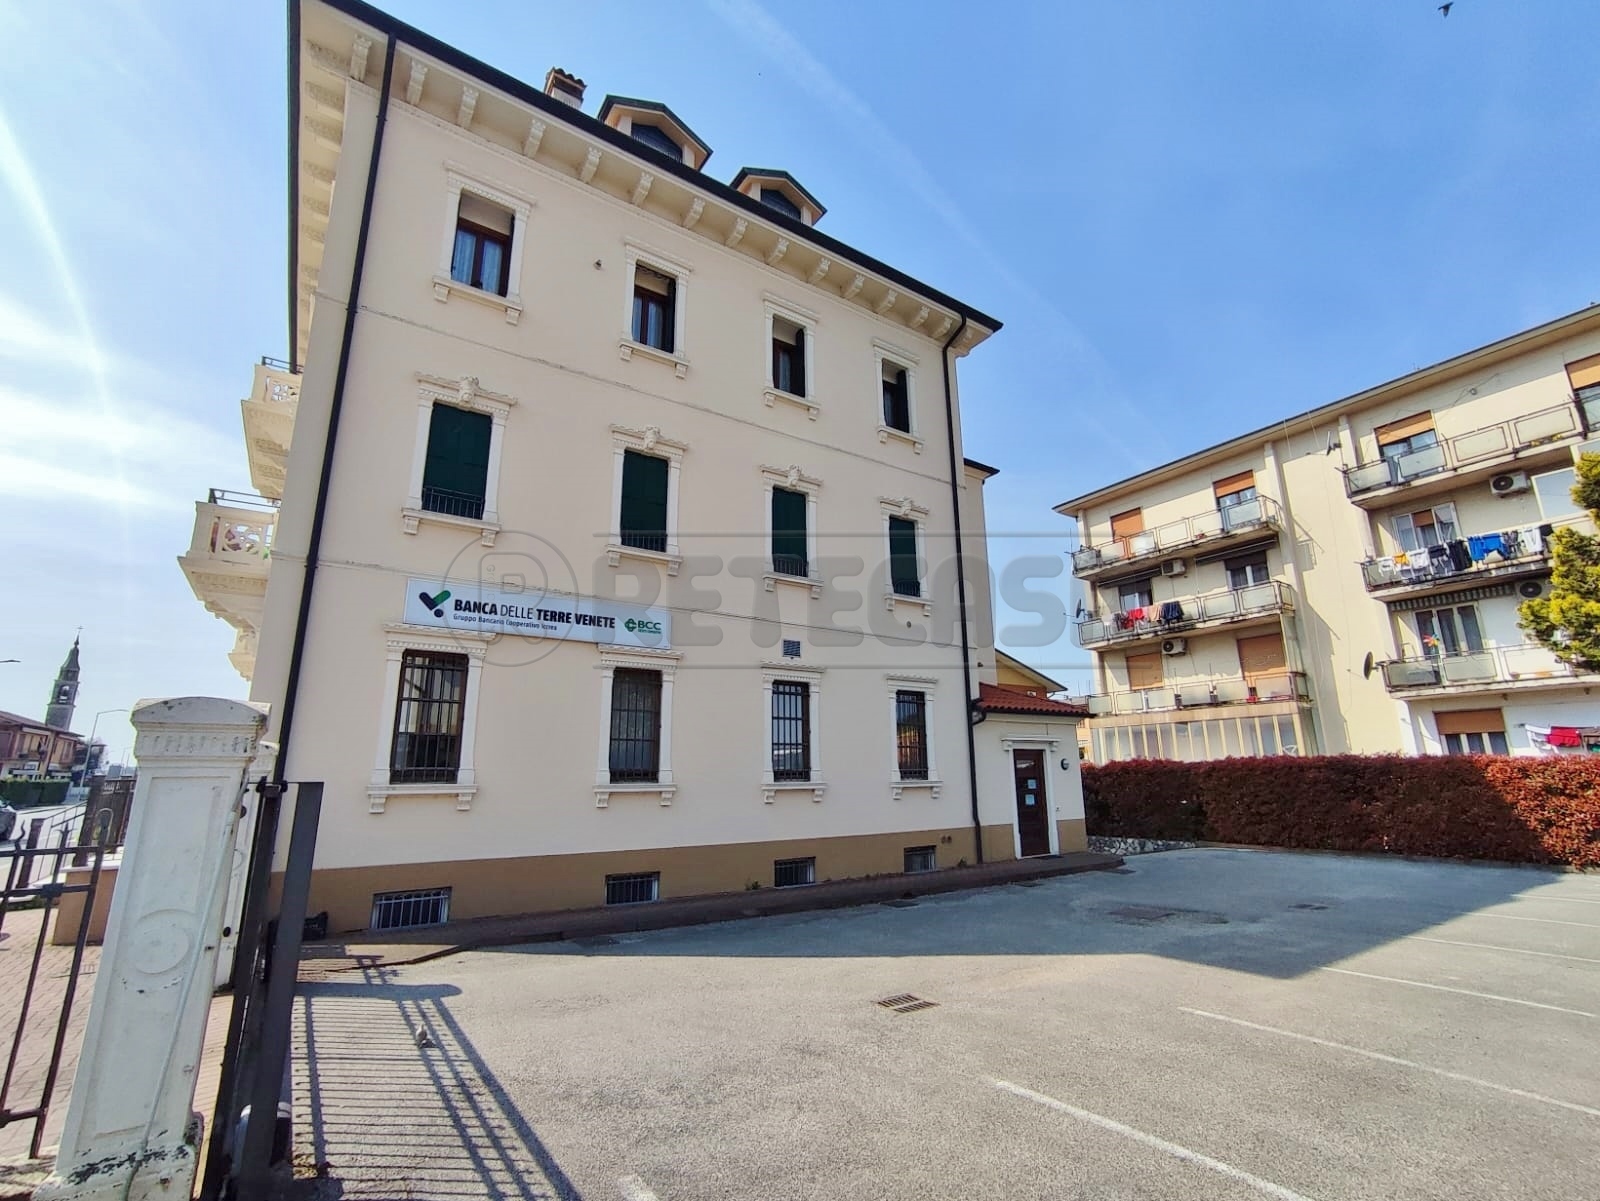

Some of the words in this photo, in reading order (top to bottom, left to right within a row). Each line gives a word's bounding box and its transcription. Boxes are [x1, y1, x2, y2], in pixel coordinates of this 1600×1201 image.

[453, 613, 477, 623] Gruppo
[478, 616, 505, 626] Bancario
[505, 619, 541, 629] Cooperativo
[454, 599, 498, 616] BANCA
[500, 604, 534, 620] DELLE
[536, 608, 573, 624] TERRE
[574, 613, 616, 629] VENETE
[637, 620, 662, 631] BCC
